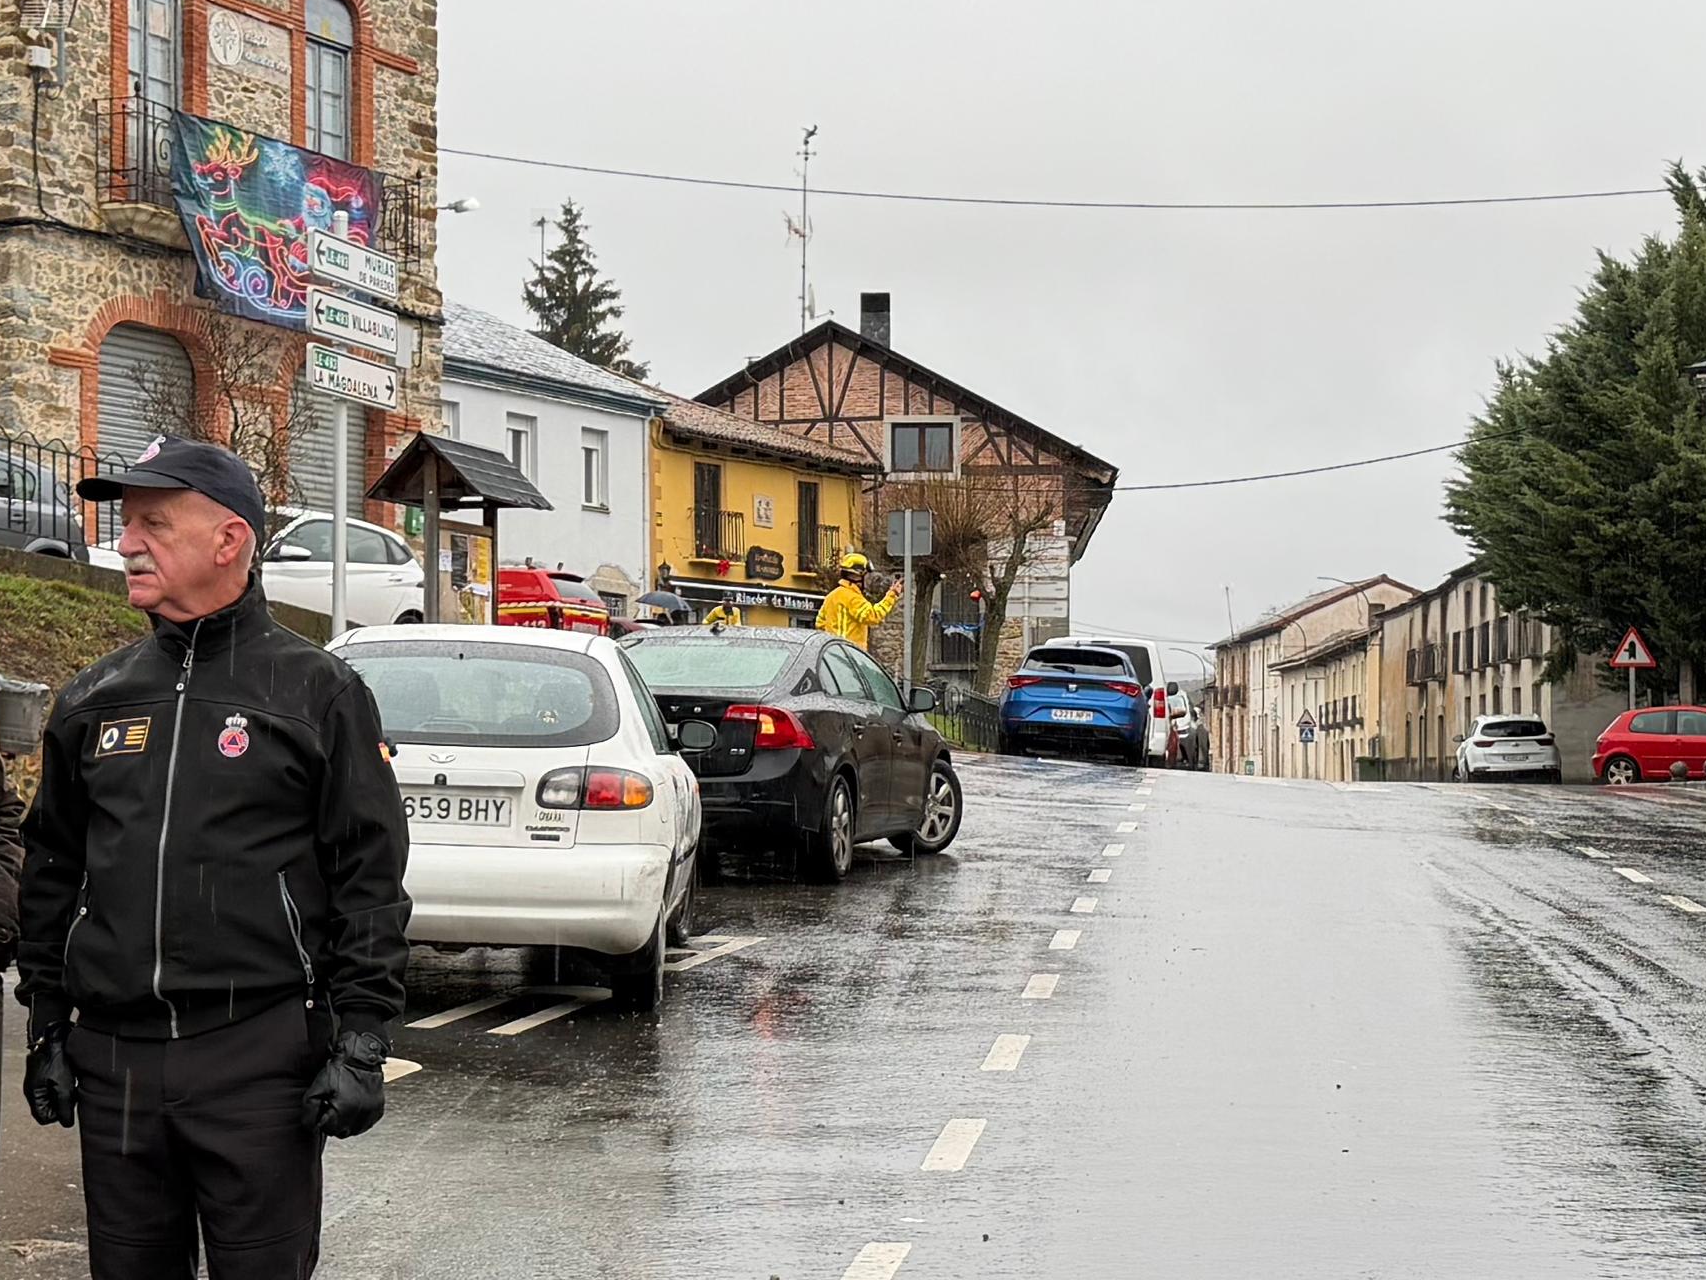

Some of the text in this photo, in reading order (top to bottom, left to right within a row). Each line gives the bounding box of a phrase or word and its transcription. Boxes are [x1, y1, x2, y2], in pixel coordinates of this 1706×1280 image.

[364, 255, 395, 278] MURIAS
[358, 271, 395, 294] DE PAREDES
[351, 314, 395, 342] VILLABLINO
[313, 369, 379, 400] LA MAGDALENA
[735, 592, 767, 604] Rincón
[773, 595, 782, 606] de
[403, 796, 505, 823] 659 BHY
